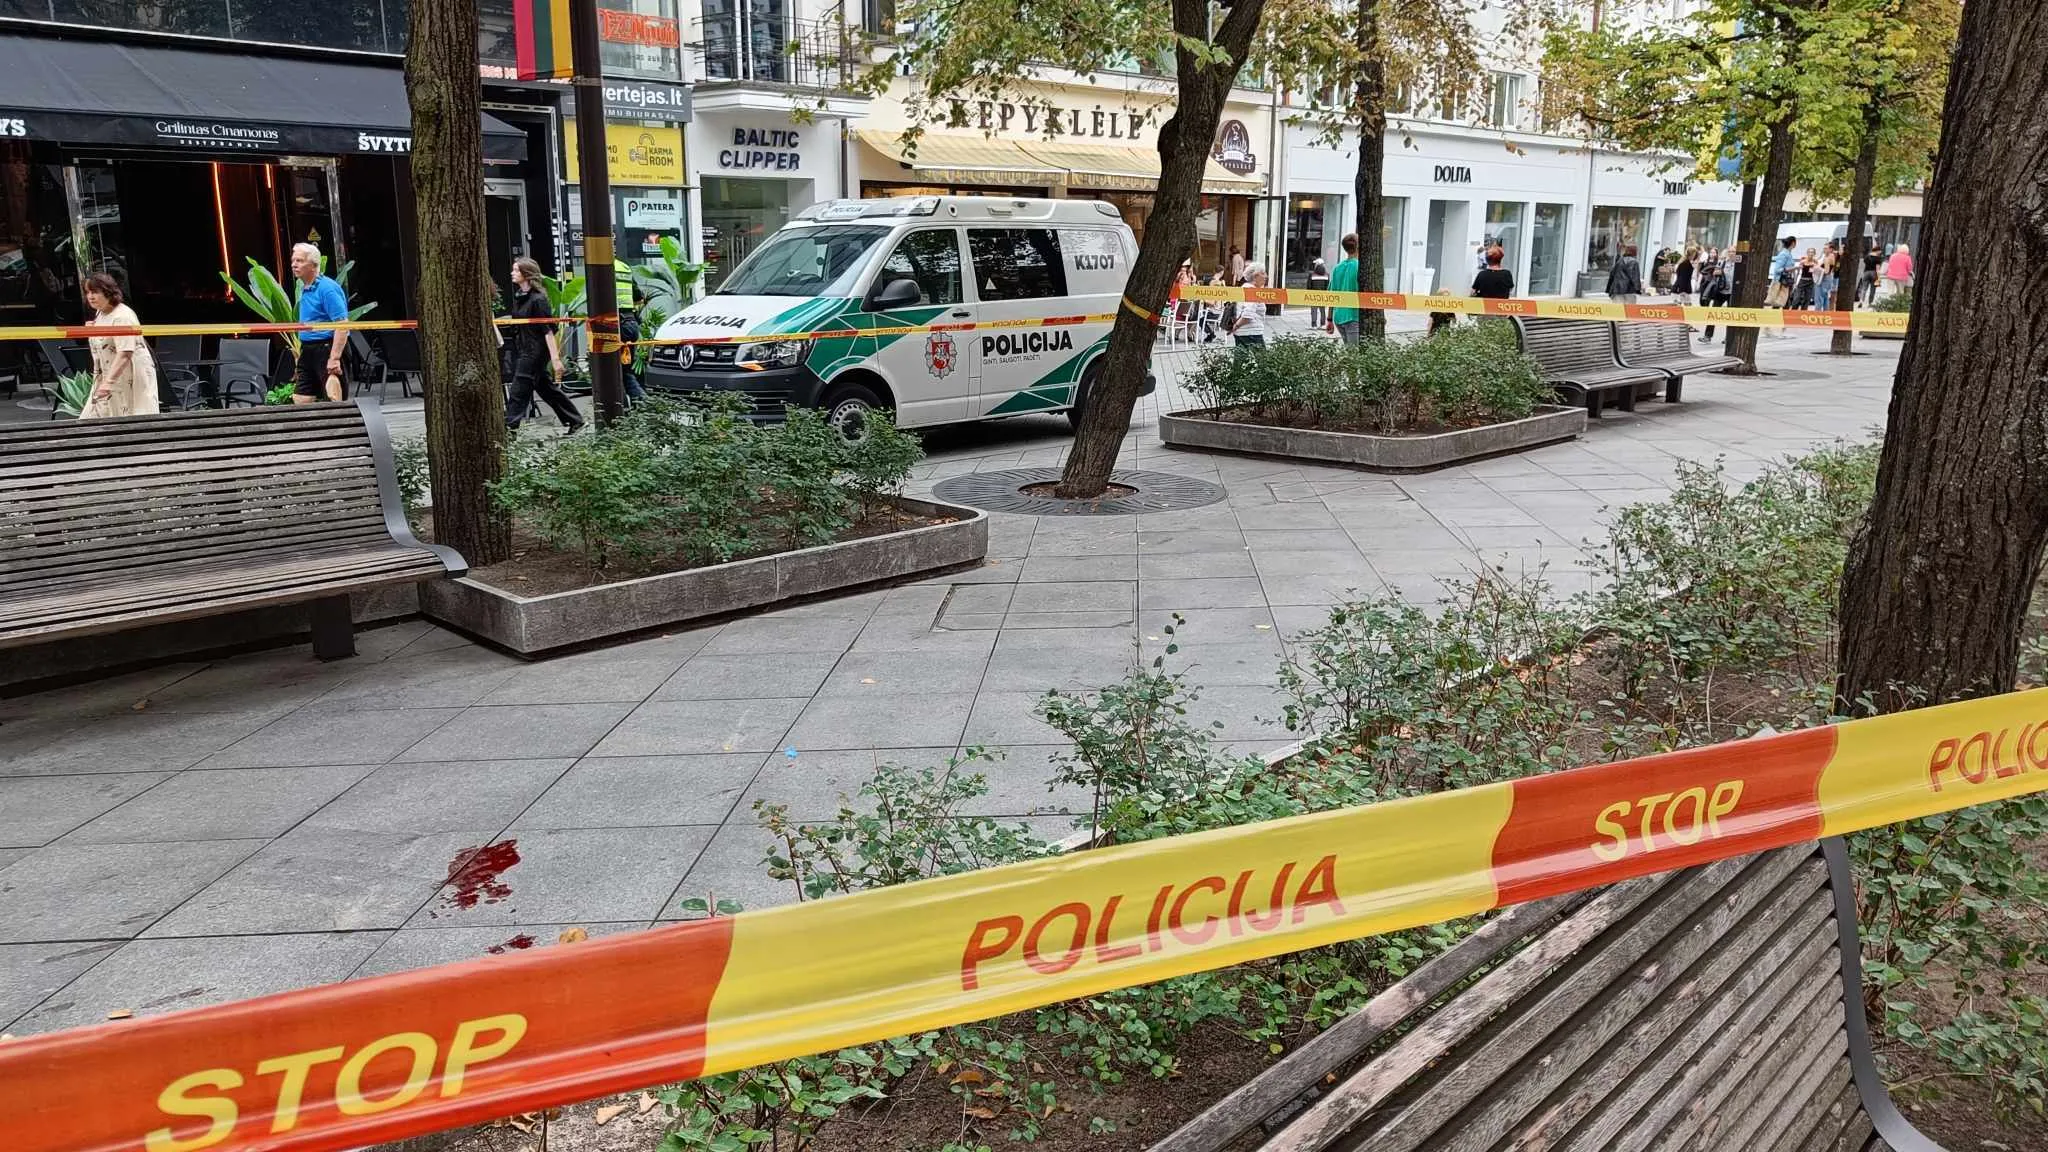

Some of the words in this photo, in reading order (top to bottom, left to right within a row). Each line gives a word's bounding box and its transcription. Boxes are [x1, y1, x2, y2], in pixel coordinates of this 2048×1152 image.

[212, 125, 278, 138] Cinamonas
[734, 128, 800, 148] BALTIC
[649, 147, 673, 156] KARMA
[719, 150, 800, 170] CLIPPER
[649, 156, 674, 167] ROOM
[1434, 165, 1472, 183] DOLITA
[641, 203, 675, 211] PATERA
[1074, 254, 1115, 271] K1707
[670, 315, 748, 329] POLICIJA
[982, 330, 1073, 357] POLICIJA
[1591, 779, 1745, 864] STOP
[960, 853, 1347, 990] POLICIJA
[145, 1013, 528, 1152] STOP
